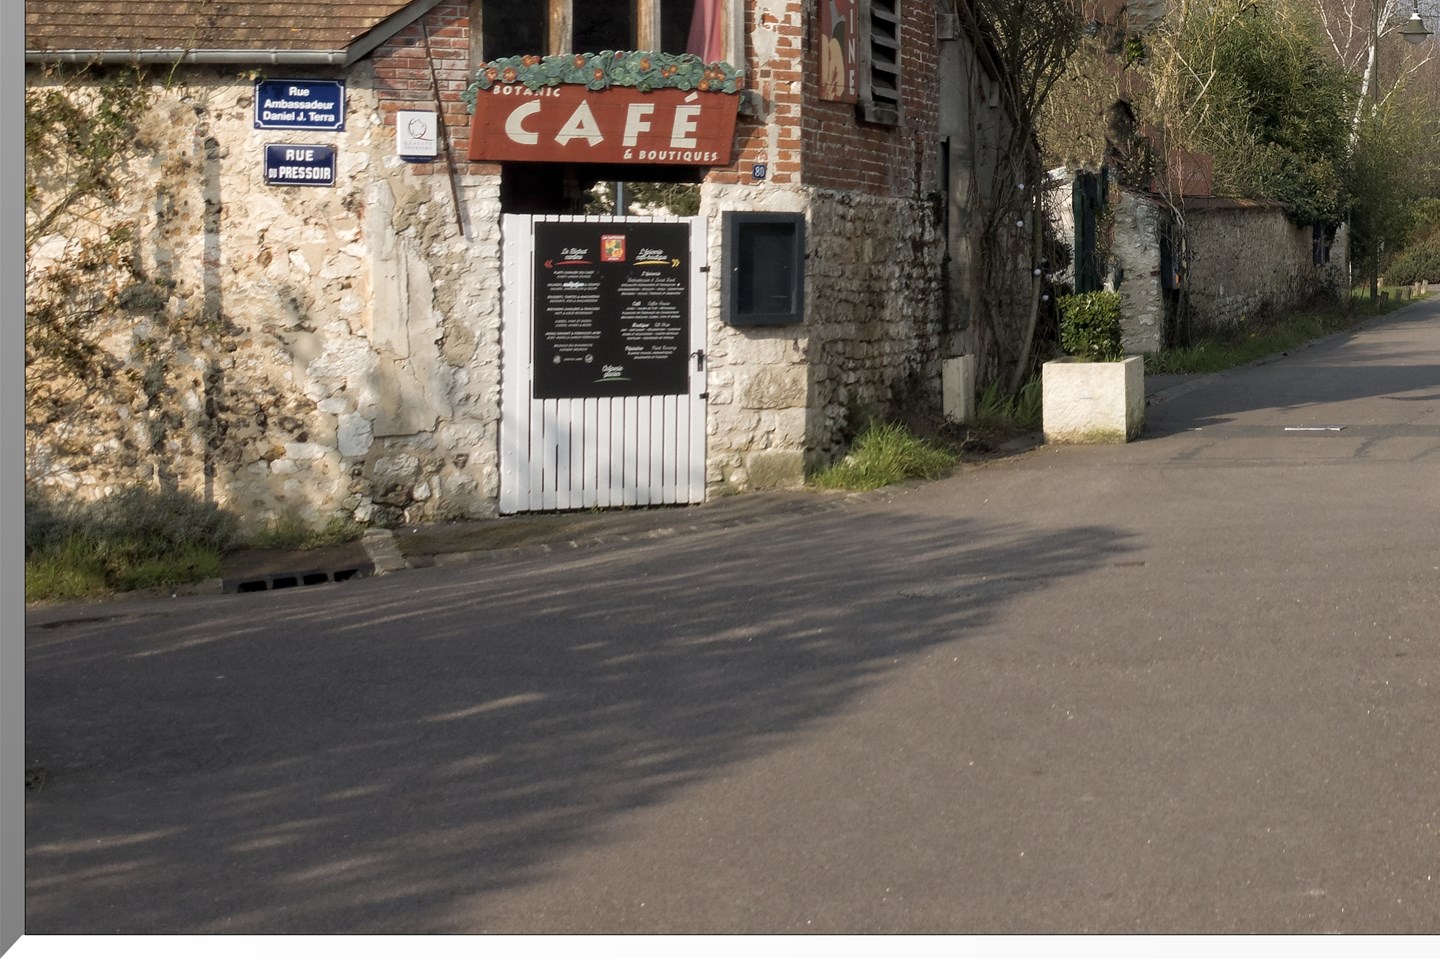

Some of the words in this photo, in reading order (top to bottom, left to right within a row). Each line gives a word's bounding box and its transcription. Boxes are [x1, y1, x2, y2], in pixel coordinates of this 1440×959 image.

[288, 86, 310, 97] Rue
[493, 84, 560, 98] BOTANIC
[264, 99, 334, 110] Ambassadeur
[263, 111, 295, 121] Daniel
[297, 112, 307, 122] J.
[310, 112, 335, 122] Terra
[504, 91, 702, 148] CAFÉ
[286, 150, 314, 162] RUE
[623, 149, 633, 159] &
[638, 150, 718, 162] BOUTIQUES
[279, 167, 331, 180] PRESSOIR
[754, 166, 765, 178] 80
